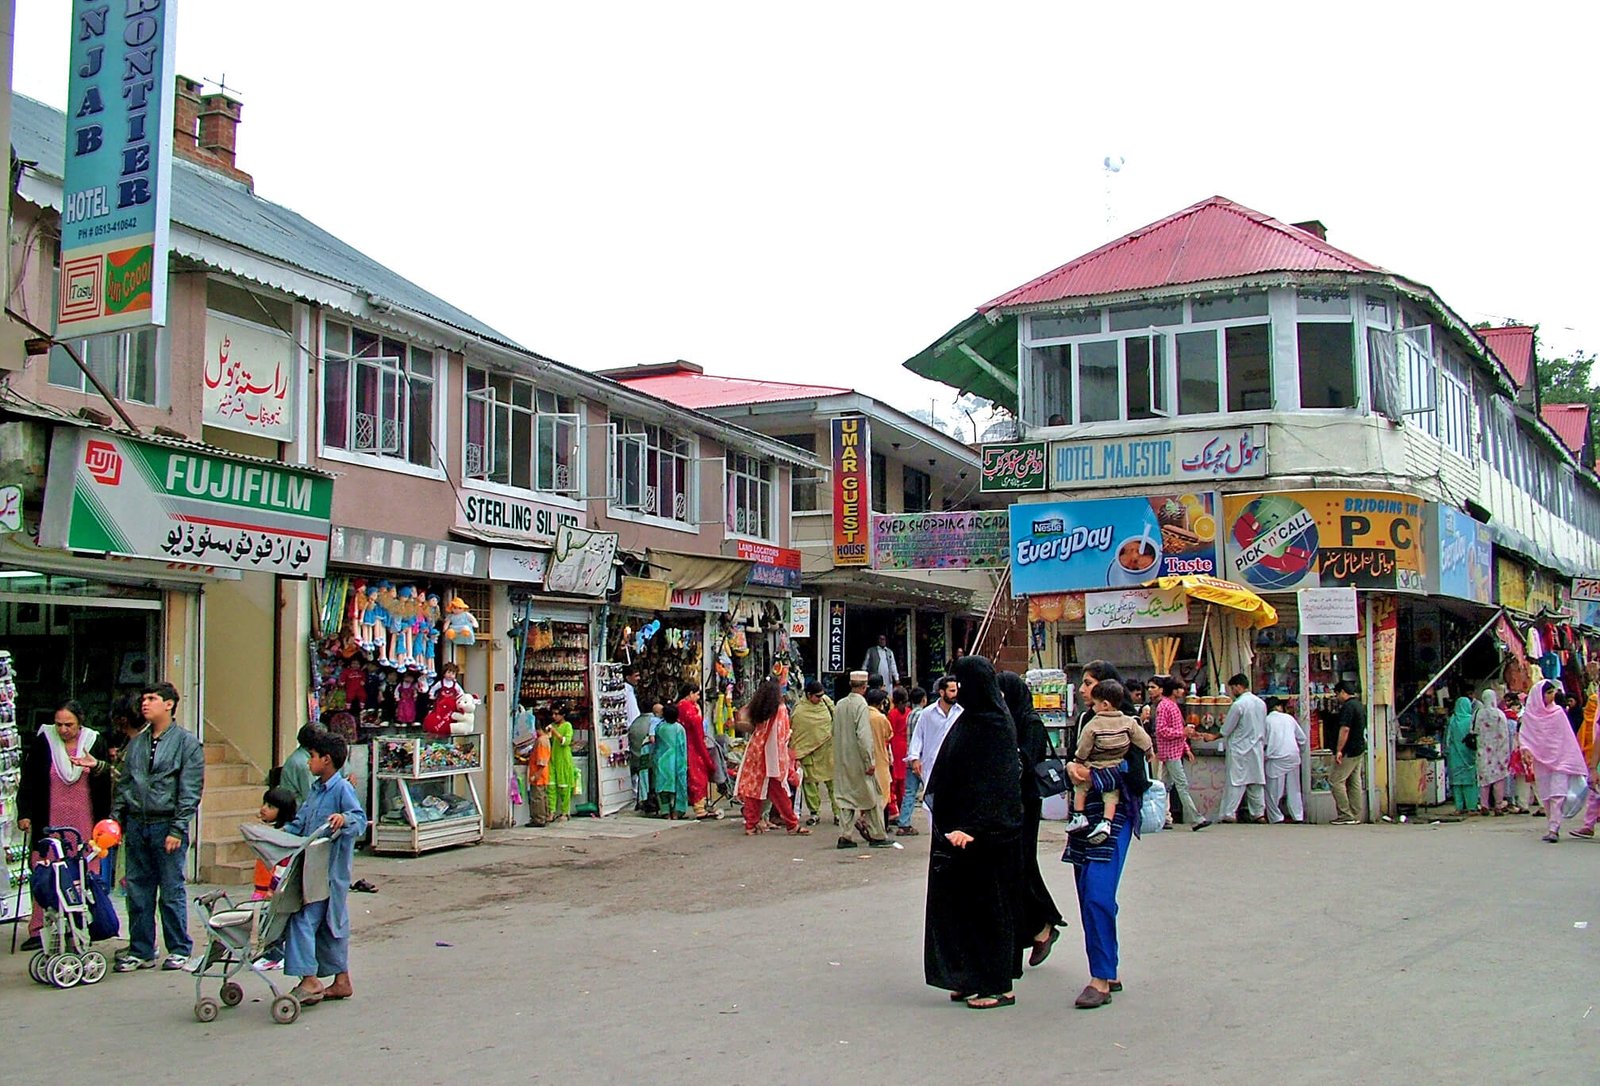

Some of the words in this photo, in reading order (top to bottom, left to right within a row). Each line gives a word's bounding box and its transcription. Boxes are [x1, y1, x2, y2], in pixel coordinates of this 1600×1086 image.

[75, 0, 109, 157] NJAB
[66, 186, 109, 225] HOTEL
[841, 420, 858, 473] UMAR
[1056, 446, 1094, 482] HOTEL
[1096, 440, 1171, 479] MAJESTIC
[166, 454, 313, 512] FUJIFILM
[467, 496, 531, 532] STERLING
[841, 477, 859, 543] GUEST
[1344, 497, 1402, 514] BRIDGING
[879, 519, 905, 534] SYED
[908, 517, 965, 531] SHOPPING
[1017, 525, 1113, 565] EveryDay
[1235, 543, 1264, 571] PICK
[1278, 512, 1312, 540] CALL
[272, 537, 311, 569] نواز
[738, 542, 753, 553] LAND
[753, 545, 779, 557] LOCATORS
[837, 544, 866, 556] HOUSE
[1164, 556, 1213, 572] Taste
[831, 618, 842, 671] BAKERY
